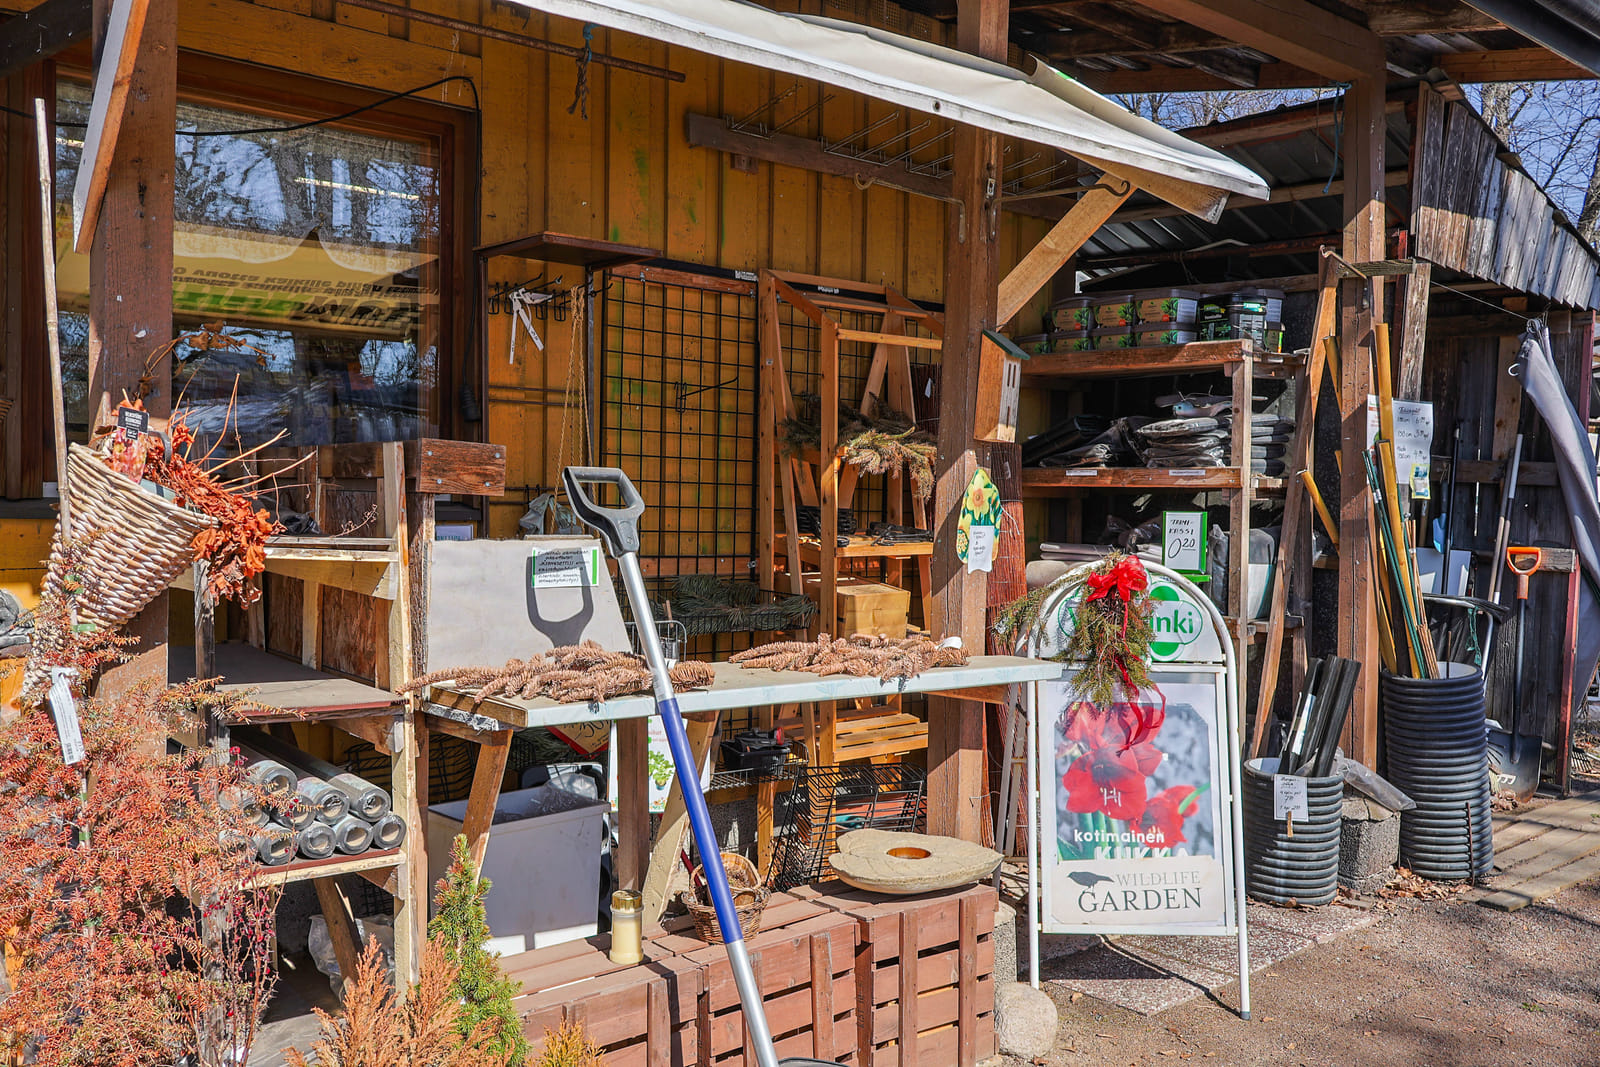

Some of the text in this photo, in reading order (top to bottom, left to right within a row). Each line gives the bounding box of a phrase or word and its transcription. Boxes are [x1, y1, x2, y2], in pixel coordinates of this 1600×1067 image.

[1074, 829, 1165, 843] kotimainen
[1116, 871, 1201, 887] WILDLIFE
[1078, 887, 1203, 913] GARDEN
